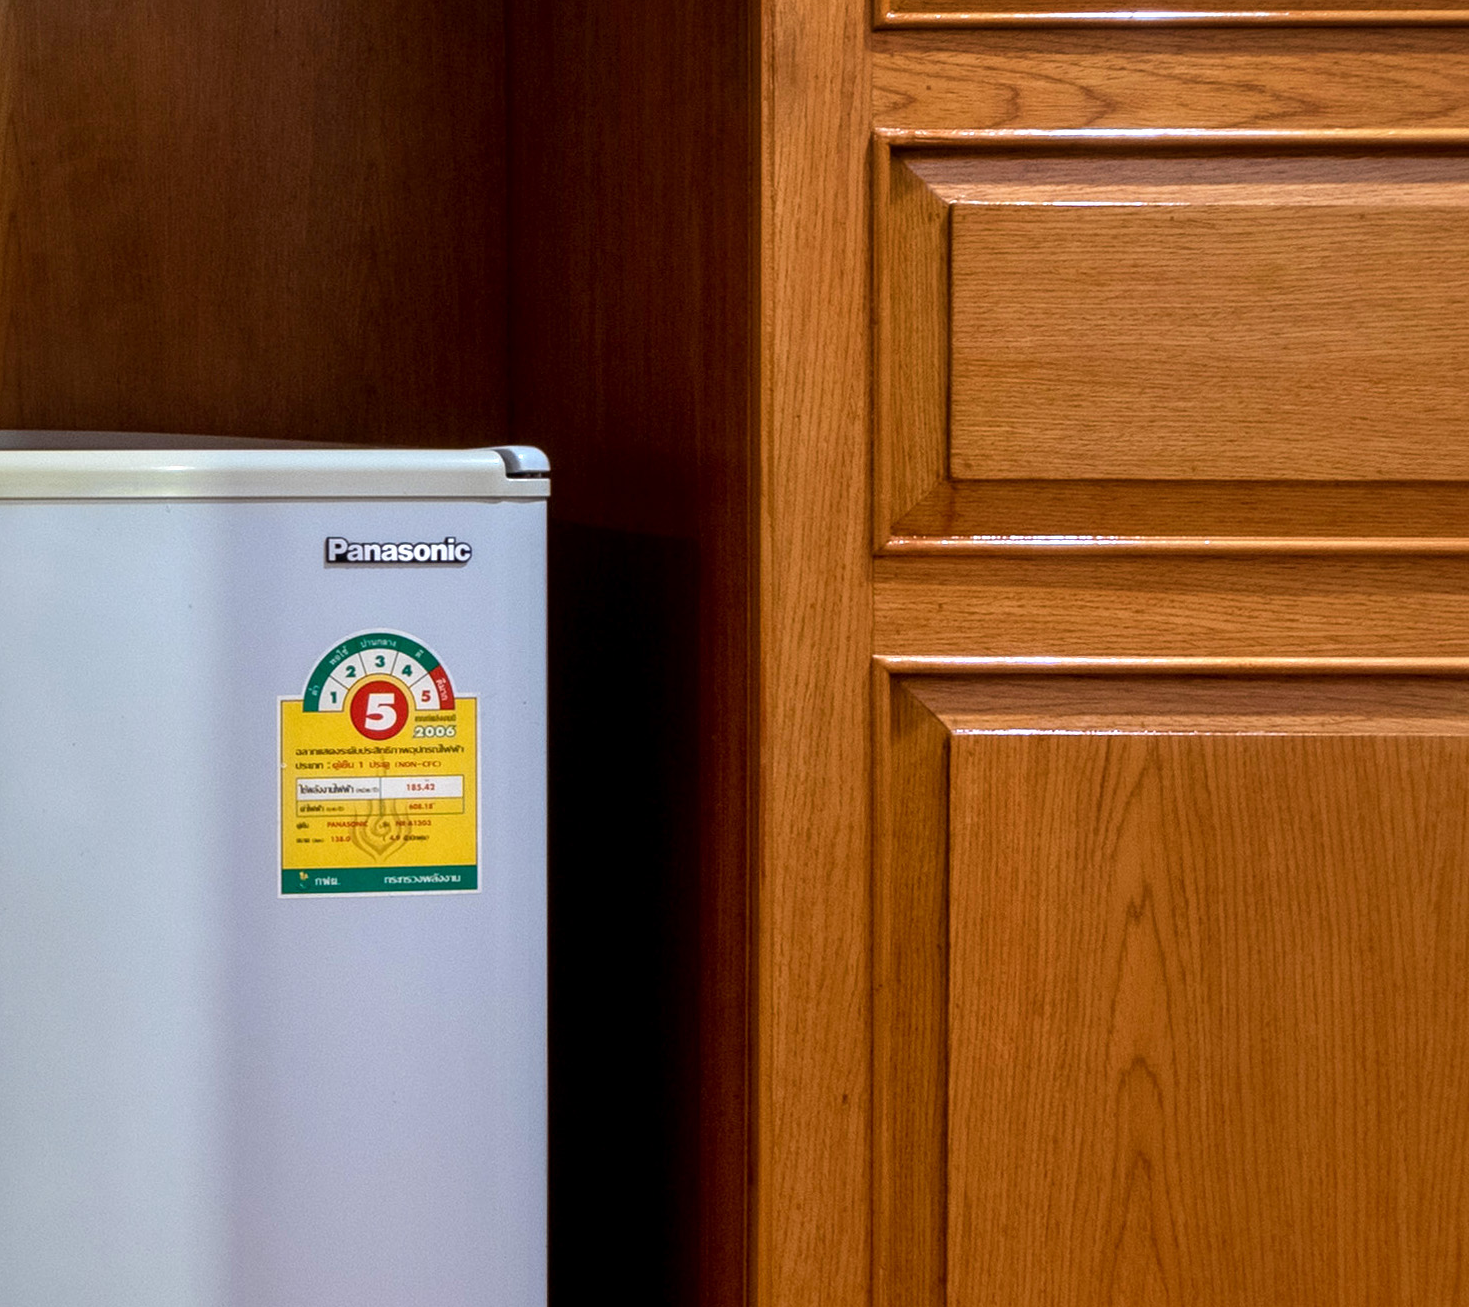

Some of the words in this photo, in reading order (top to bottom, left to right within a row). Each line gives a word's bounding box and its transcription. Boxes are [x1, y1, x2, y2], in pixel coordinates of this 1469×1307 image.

[327, 537, 472, 562] Panasonic
[375, 655, 385, 668] 3
[345, 665, 356, 678] 2
[401, 664, 413, 677] 4
[330, 691, 337, 704] 1
[421, 690, 431, 703] 5
[364, 692, 398, 732] 5
[413, 725, 456, 738] 2006
[406, 783, 435, 791] 185.42
